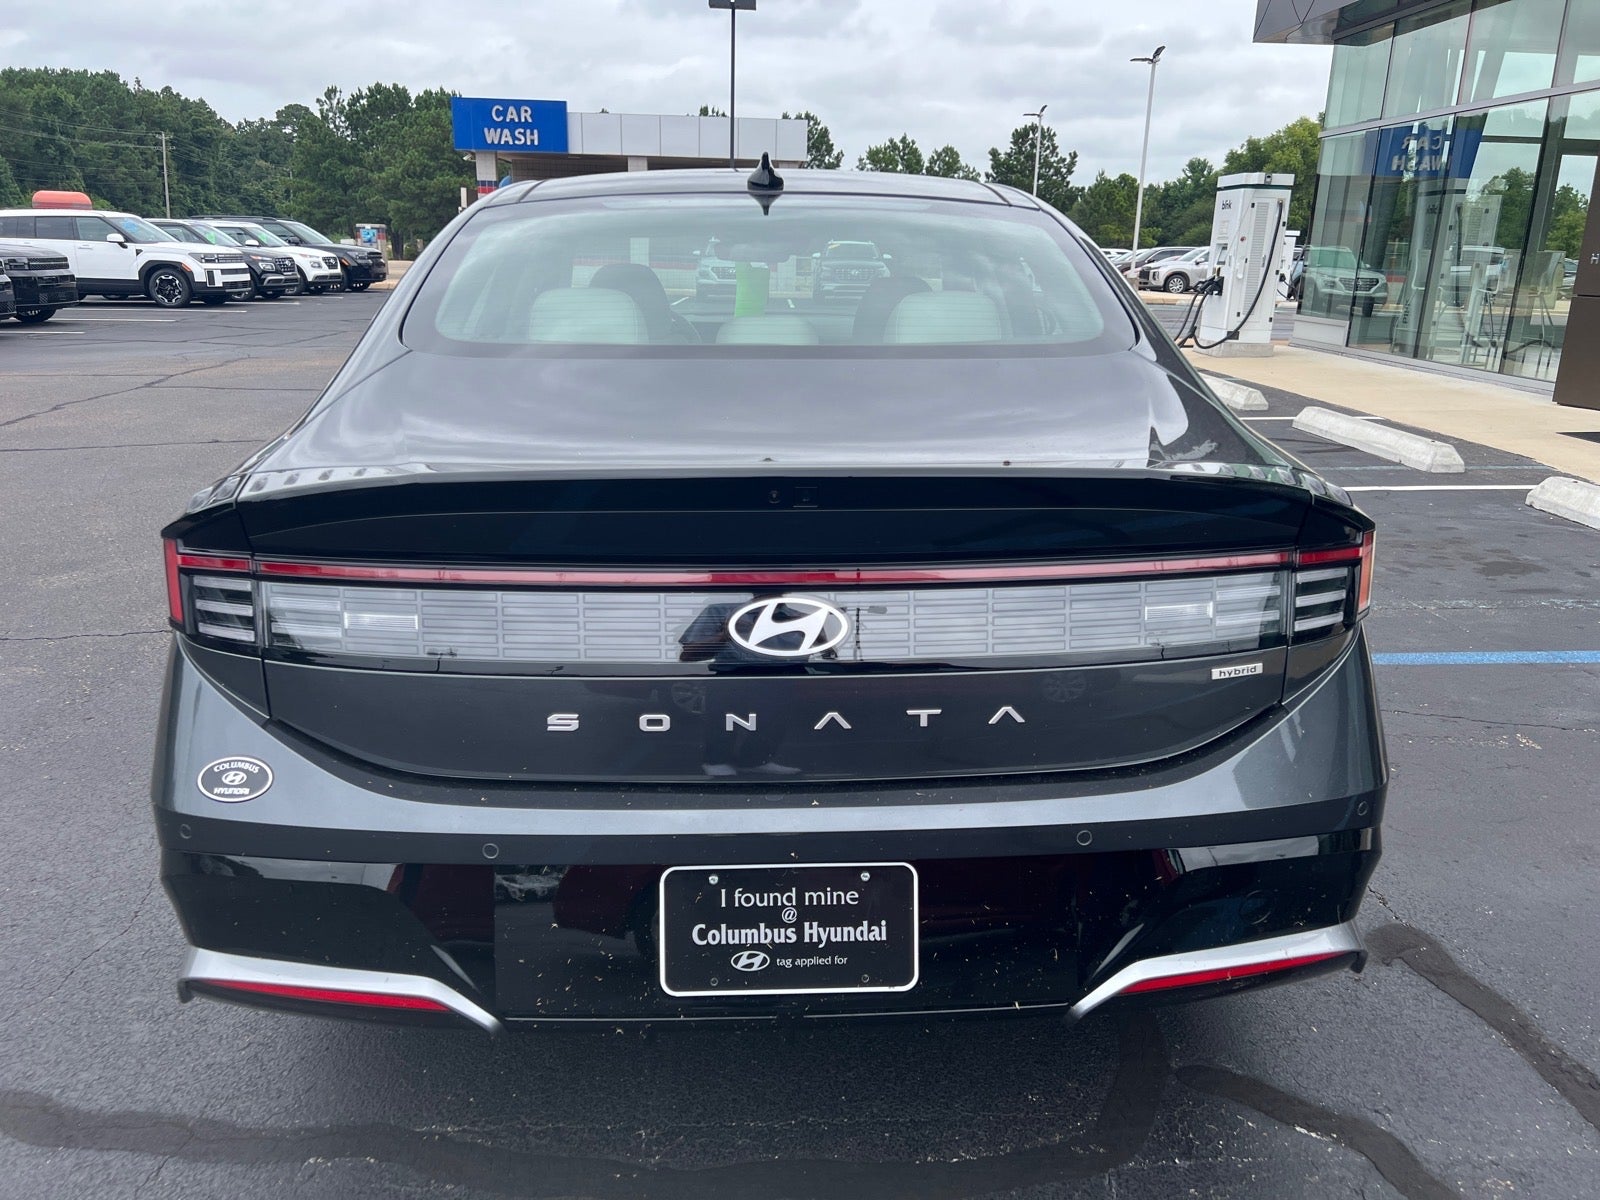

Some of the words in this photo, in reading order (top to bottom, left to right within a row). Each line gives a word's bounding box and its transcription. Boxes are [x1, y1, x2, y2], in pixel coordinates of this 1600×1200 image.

[491, 105, 532, 122] CAR
[483, 127, 539, 146] WASH
[1218, 665, 1257, 678] hybrid
[546, 705, 1026, 733] SONATA
[213, 761, 260, 773] COLUMBUS
[720, 888, 726, 907] I
[734, 887, 797, 906] found
[804, 887, 859, 905] mine
[781, 906, 797, 923] @
[691, 922, 797, 945] Columbus
[803, 919, 887, 948] Hyundai
[776, 957, 792, 968] tag
[795, 955, 831, 967] applied
[834, 955, 848, 965] for
